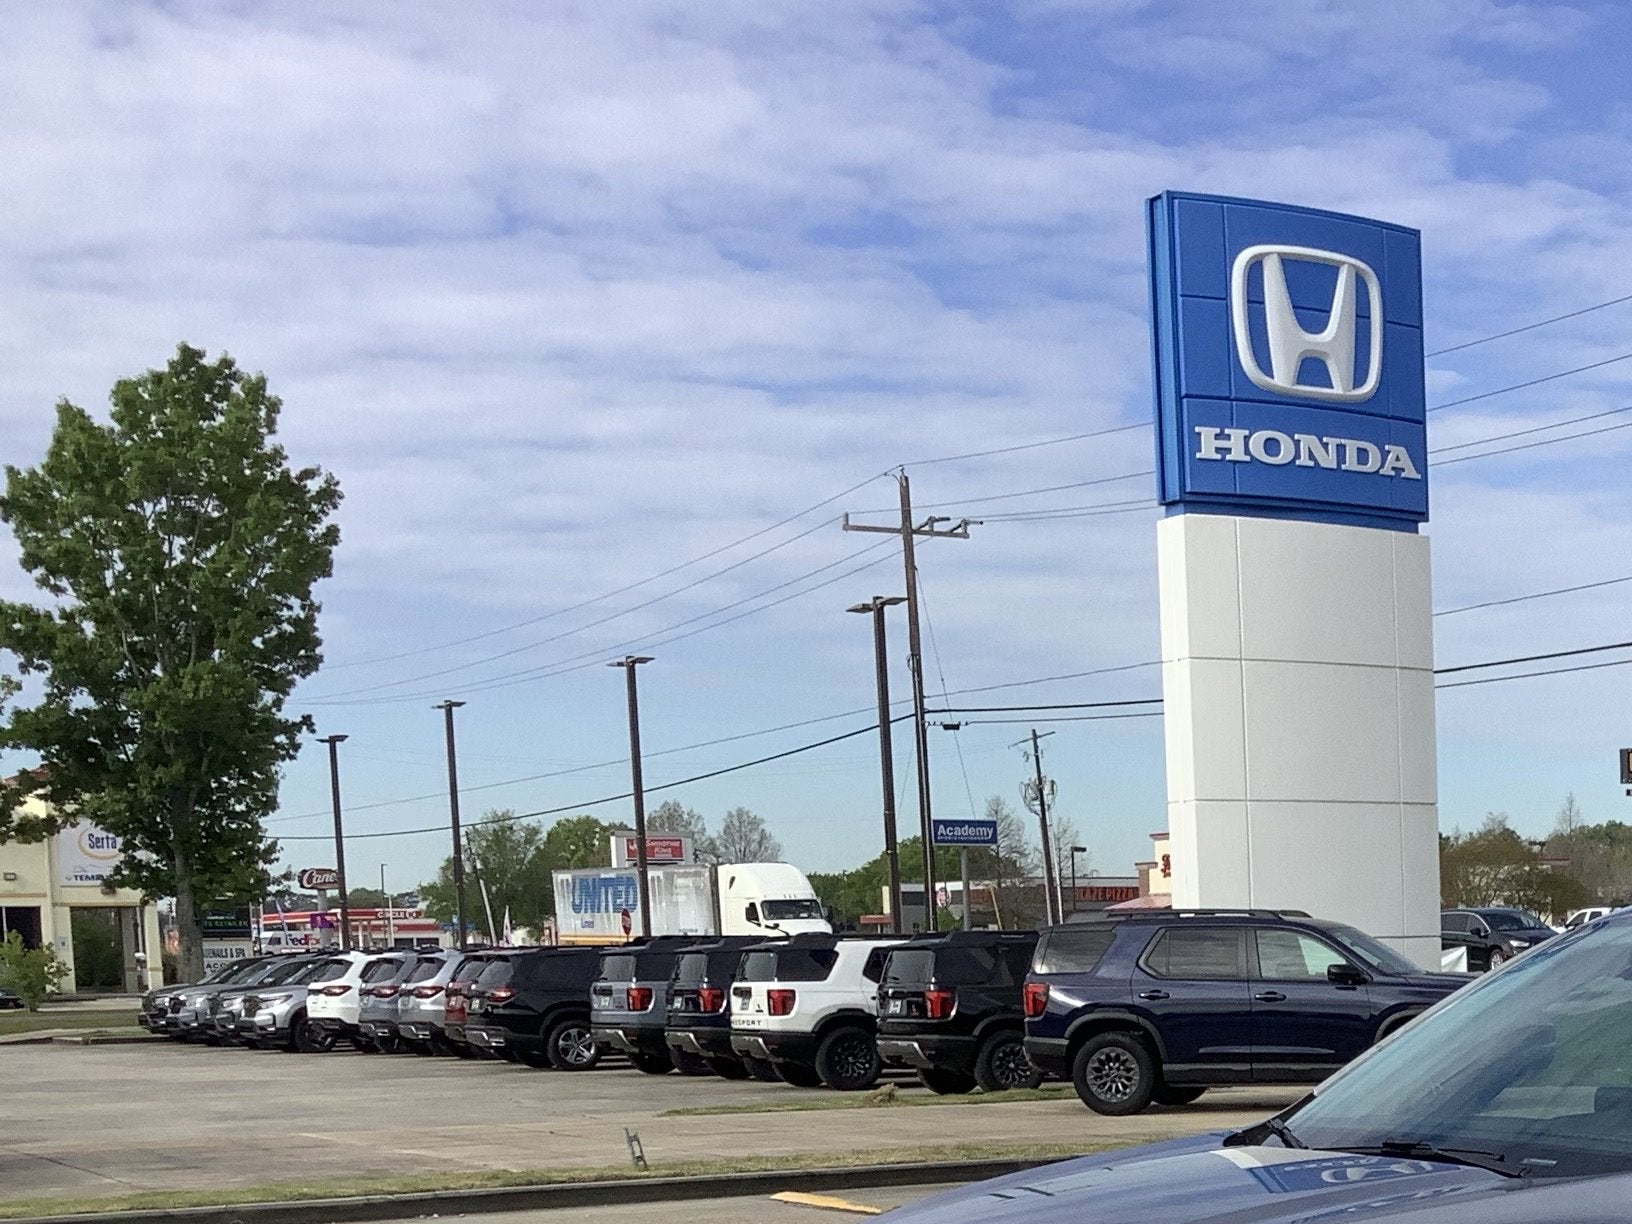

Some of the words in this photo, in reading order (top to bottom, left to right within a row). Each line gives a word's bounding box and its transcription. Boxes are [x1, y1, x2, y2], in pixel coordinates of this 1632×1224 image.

[1195, 426, 1422, 480] HONDA
[87, 832, 118, 850] Serta
[936, 823, 994, 840] Academy
[571, 876, 638, 914] UNITED
